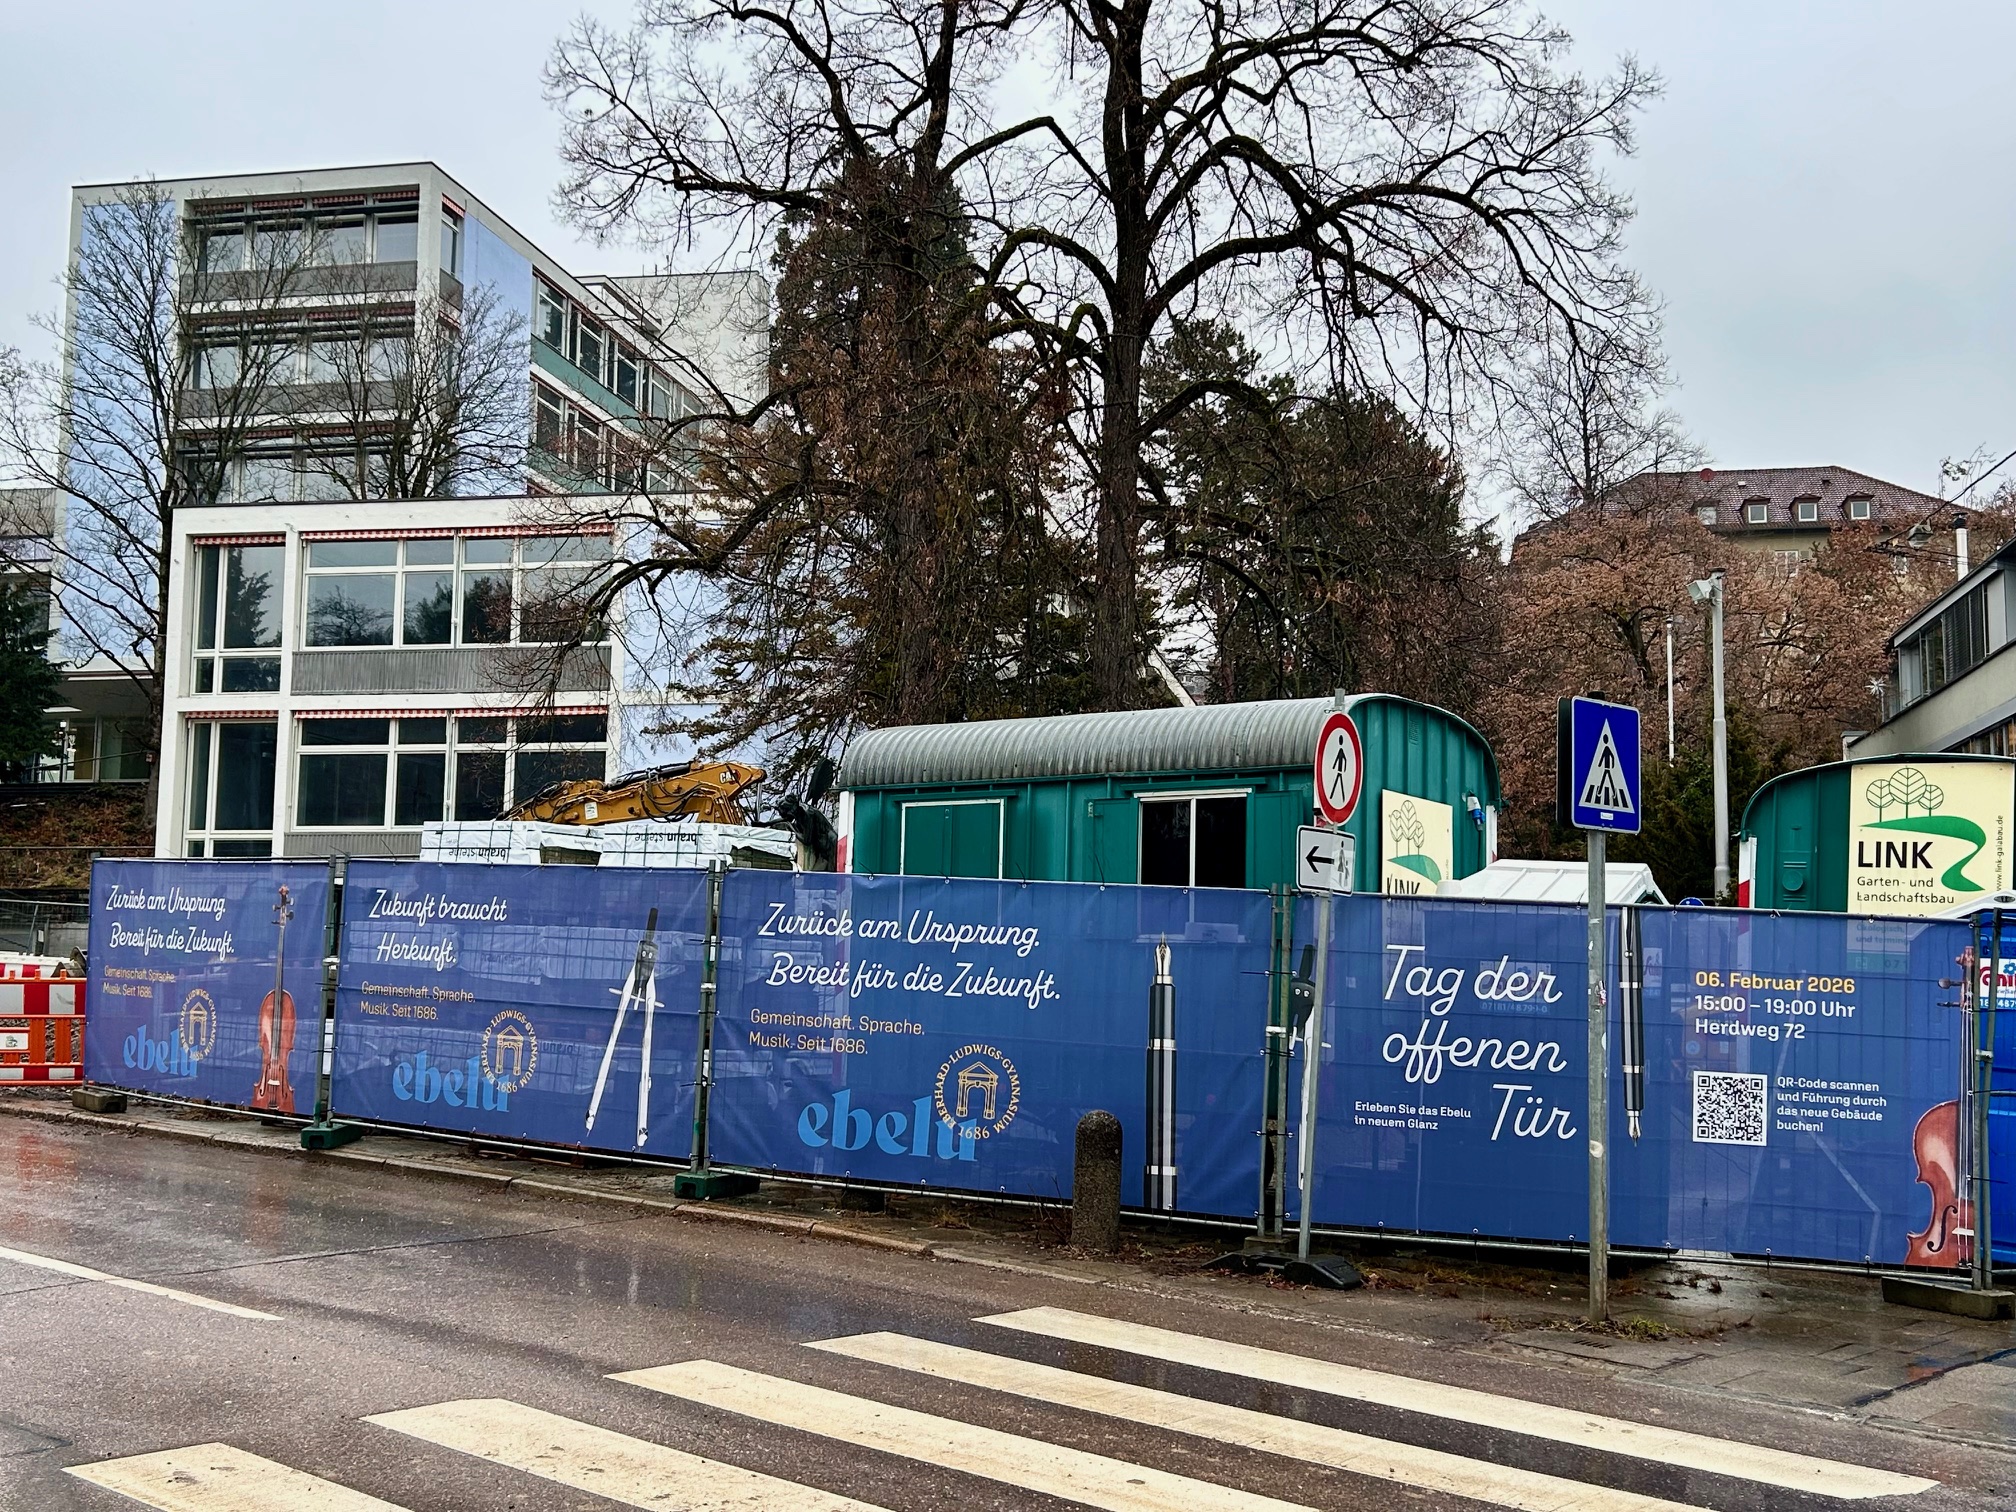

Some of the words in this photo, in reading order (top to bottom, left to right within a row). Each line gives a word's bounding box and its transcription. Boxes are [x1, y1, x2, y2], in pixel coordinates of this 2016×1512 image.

[667, 833, 697, 845] braun
[478, 848, 506, 861] braun
[1857, 841, 1934, 869] LINK
[1995, 815, 2004, 892] www.link-galabau.de
[1909, 877, 1934, 888] und
[105, 885, 146, 910] Zurück
[147, 895, 166, 911] am
[168, 886, 226, 921] Ursprung.
[369, 889, 435, 927] Zukunft
[438, 894, 508, 921] braucht
[1857, 892, 1955, 904] Landschaftsbau
[758, 902, 854, 937] Zurück
[858, 918, 901, 939] am
[907, 909, 1040, 958] Ursprung.
[109, 922, 144, 948] Bereit
[144, 926, 164, 956] für
[166, 928, 185, 949] die
[185, 926, 234, 962] Zukunft.
[376, 932, 457, 971] Herkunft.
[104, 965, 148, 980] Gemeinschaft.
[765, 951, 851, 988] Bereit
[850, 959, 898, 998] für
[903, 963, 944, 992] die
[944, 962, 1061, 1010] Zukunft.
[1384, 944, 1465, 1016] Tag
[1473, 955, 1563, 1004] der
[1695, 971, 1725, 988] 06.
[1730, 972, 1804, 991] Februar
[1807, 976, 1856, 994] 2026
[123, 984, 136, 997] Seit
[361, 981, 430, 999] Gemeinschaft.
[432, 986, 476, 1003] Sprache.
[360, 1001, 390, 1015] Musik.
[392, 1003, 411, 1018] Seit
[413, 1005, 439, 1020] 1686.
[1694, 994, 1746, 1012] 15:00
[1764, 998, 1816, 1016] 19:00
[1821, 1001, 1856, 1018] Uhr
[750, 1008, 855, 1031] Gemeinschaft.
[858, 1015, 925, 1036] Sprache.
[1695, 1018, 1779, 1042] Herdweg
[1783, 1022, 1805, 1039] 72
[123, 1024, 199, 1078] ebelu
[749, 1032, 793, 1049] Musik.
[797, 1034, 826, 1051] Seit
[829, 1037, 868, 1055] 1686.
[1382, 1019, 1567, 1084] offenen
[392, 1049, 510, 1112] ebelu
[496, 1081, 518, 1094] 1686
[1777, 1076, 1828, 1089] QR-Code
[1829, 1081, 1880, 1092] scannen
[1354, 1101, 1396, 1113] Erleben
[1398, 1104, 1416, 1114] Sie
[1418, 1105, 1438, 1116] das
[1440, 1106, 1472, 1118] Ebelu
[1777, 1091, 1800, 1102] und
[1802, 1093, 1851, 1107] Führung
[1852, 1095, 1887, 1107] durch
[1354, 1115, 1366, 1125] in
[1368, 1117, 1406, 1128] neuem
[1407, 1118, 1439, 1130] Glanz
[1490, 1084, 1577, 1141] Tür
[1776, 1105, 1798, 1116] das
[1800, 1108, 1829, 1118] neue
[1831, 1108, 1883, 1121] Gebäude
[797, 1088, 978, 1162] ebelu
[958, 1126, 990, 1140] 1686
[1776, 1119, 1824, 1132] buchen!
